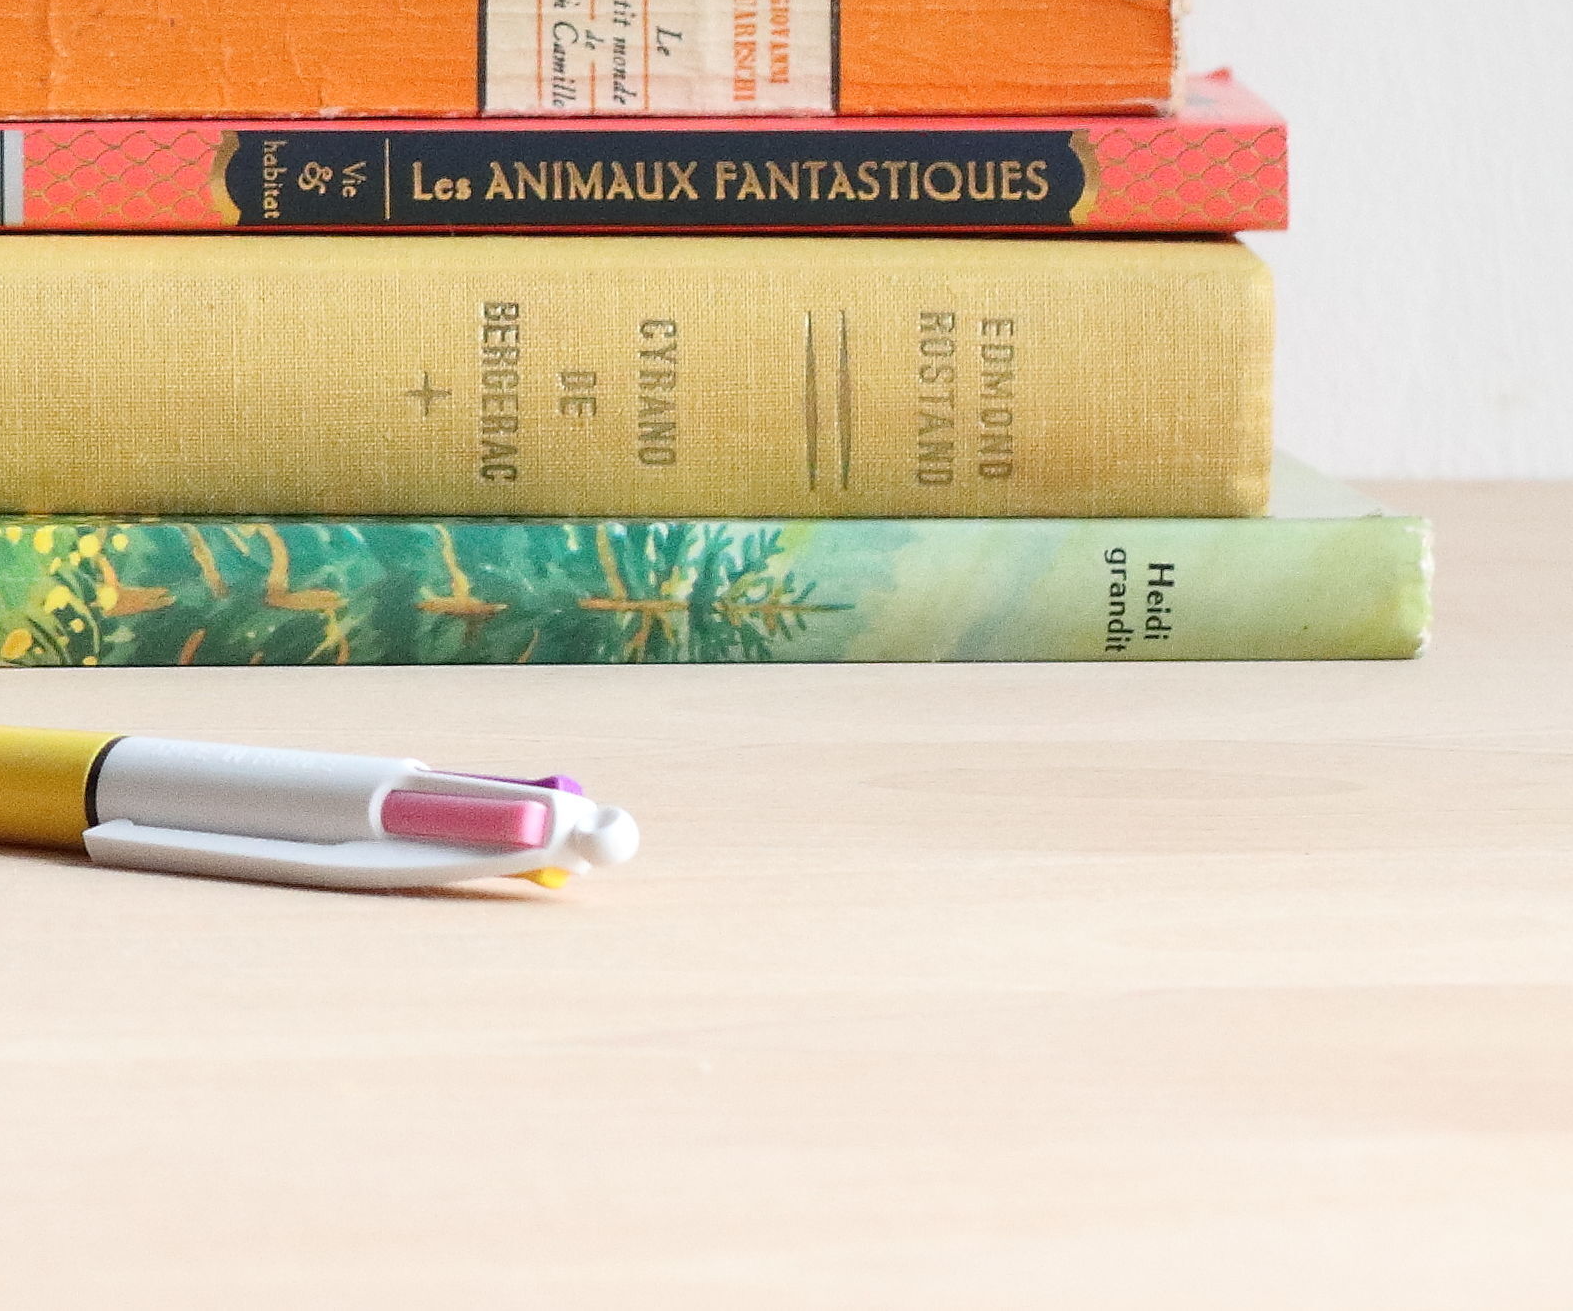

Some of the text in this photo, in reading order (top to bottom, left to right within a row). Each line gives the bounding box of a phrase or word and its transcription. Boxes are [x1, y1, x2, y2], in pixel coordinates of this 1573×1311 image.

[585, 29, 603, 50] de
[613, 37, 637, 104] monde
[655, 25, 683, 57] Le
[261, 140, 288, 219] habitat
[297, 160, 334, 194] &
[342, 160, 369, 198] Vie
[412, 160, 1049, 202] Les ANIMAUX FANTASTIQUES
[479, 301, 520, 483] BERGERAC
[558, 370, 597, 418] DE
[637, 317, 678, 468] CYRANO
[915, 311, 956, 487] ROSTAND
[977, 317, 1015, 480] EDMOND
[1104, 547, 1134, 652] grandit
[1144, 564, 1174, 640] Heidi
